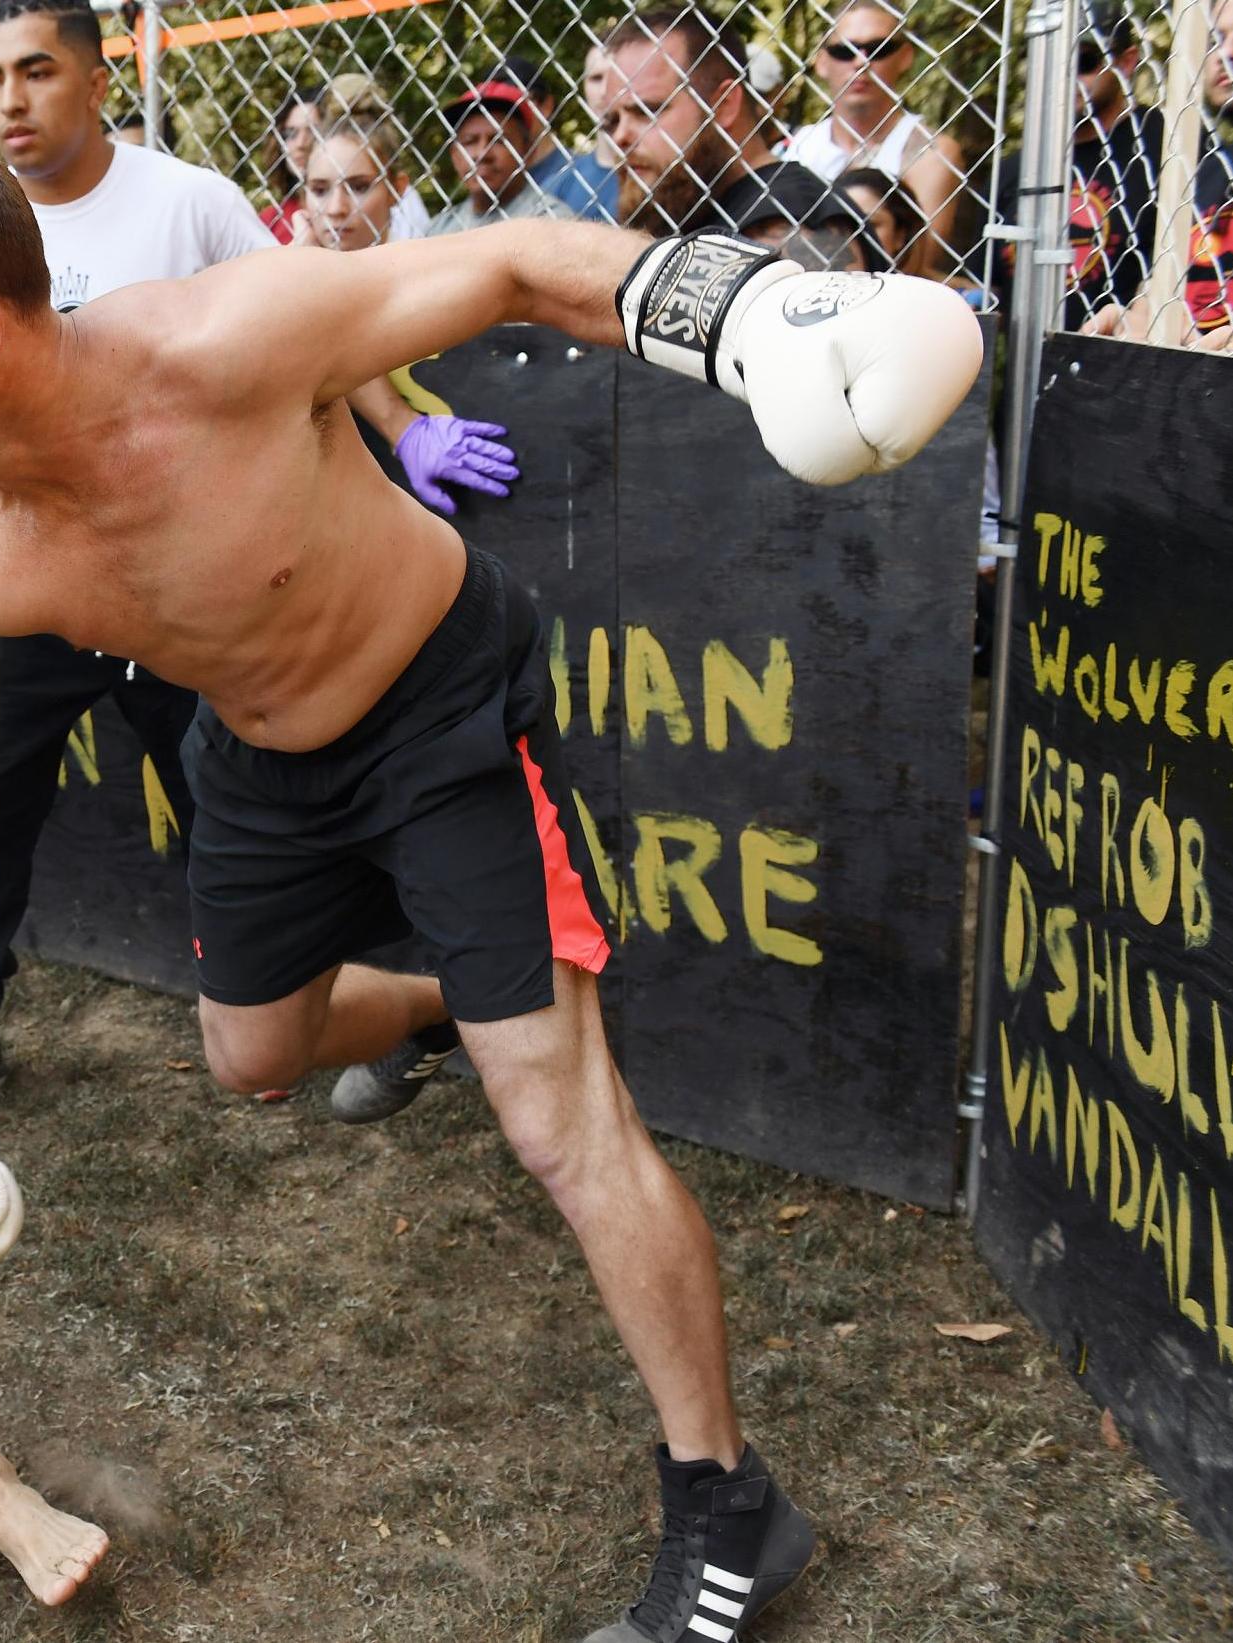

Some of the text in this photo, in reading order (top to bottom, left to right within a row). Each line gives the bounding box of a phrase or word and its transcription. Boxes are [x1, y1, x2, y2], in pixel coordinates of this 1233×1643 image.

[1034, 512, 1107, 608] THE
[1020, 724, 1213, 951] REF ROB
